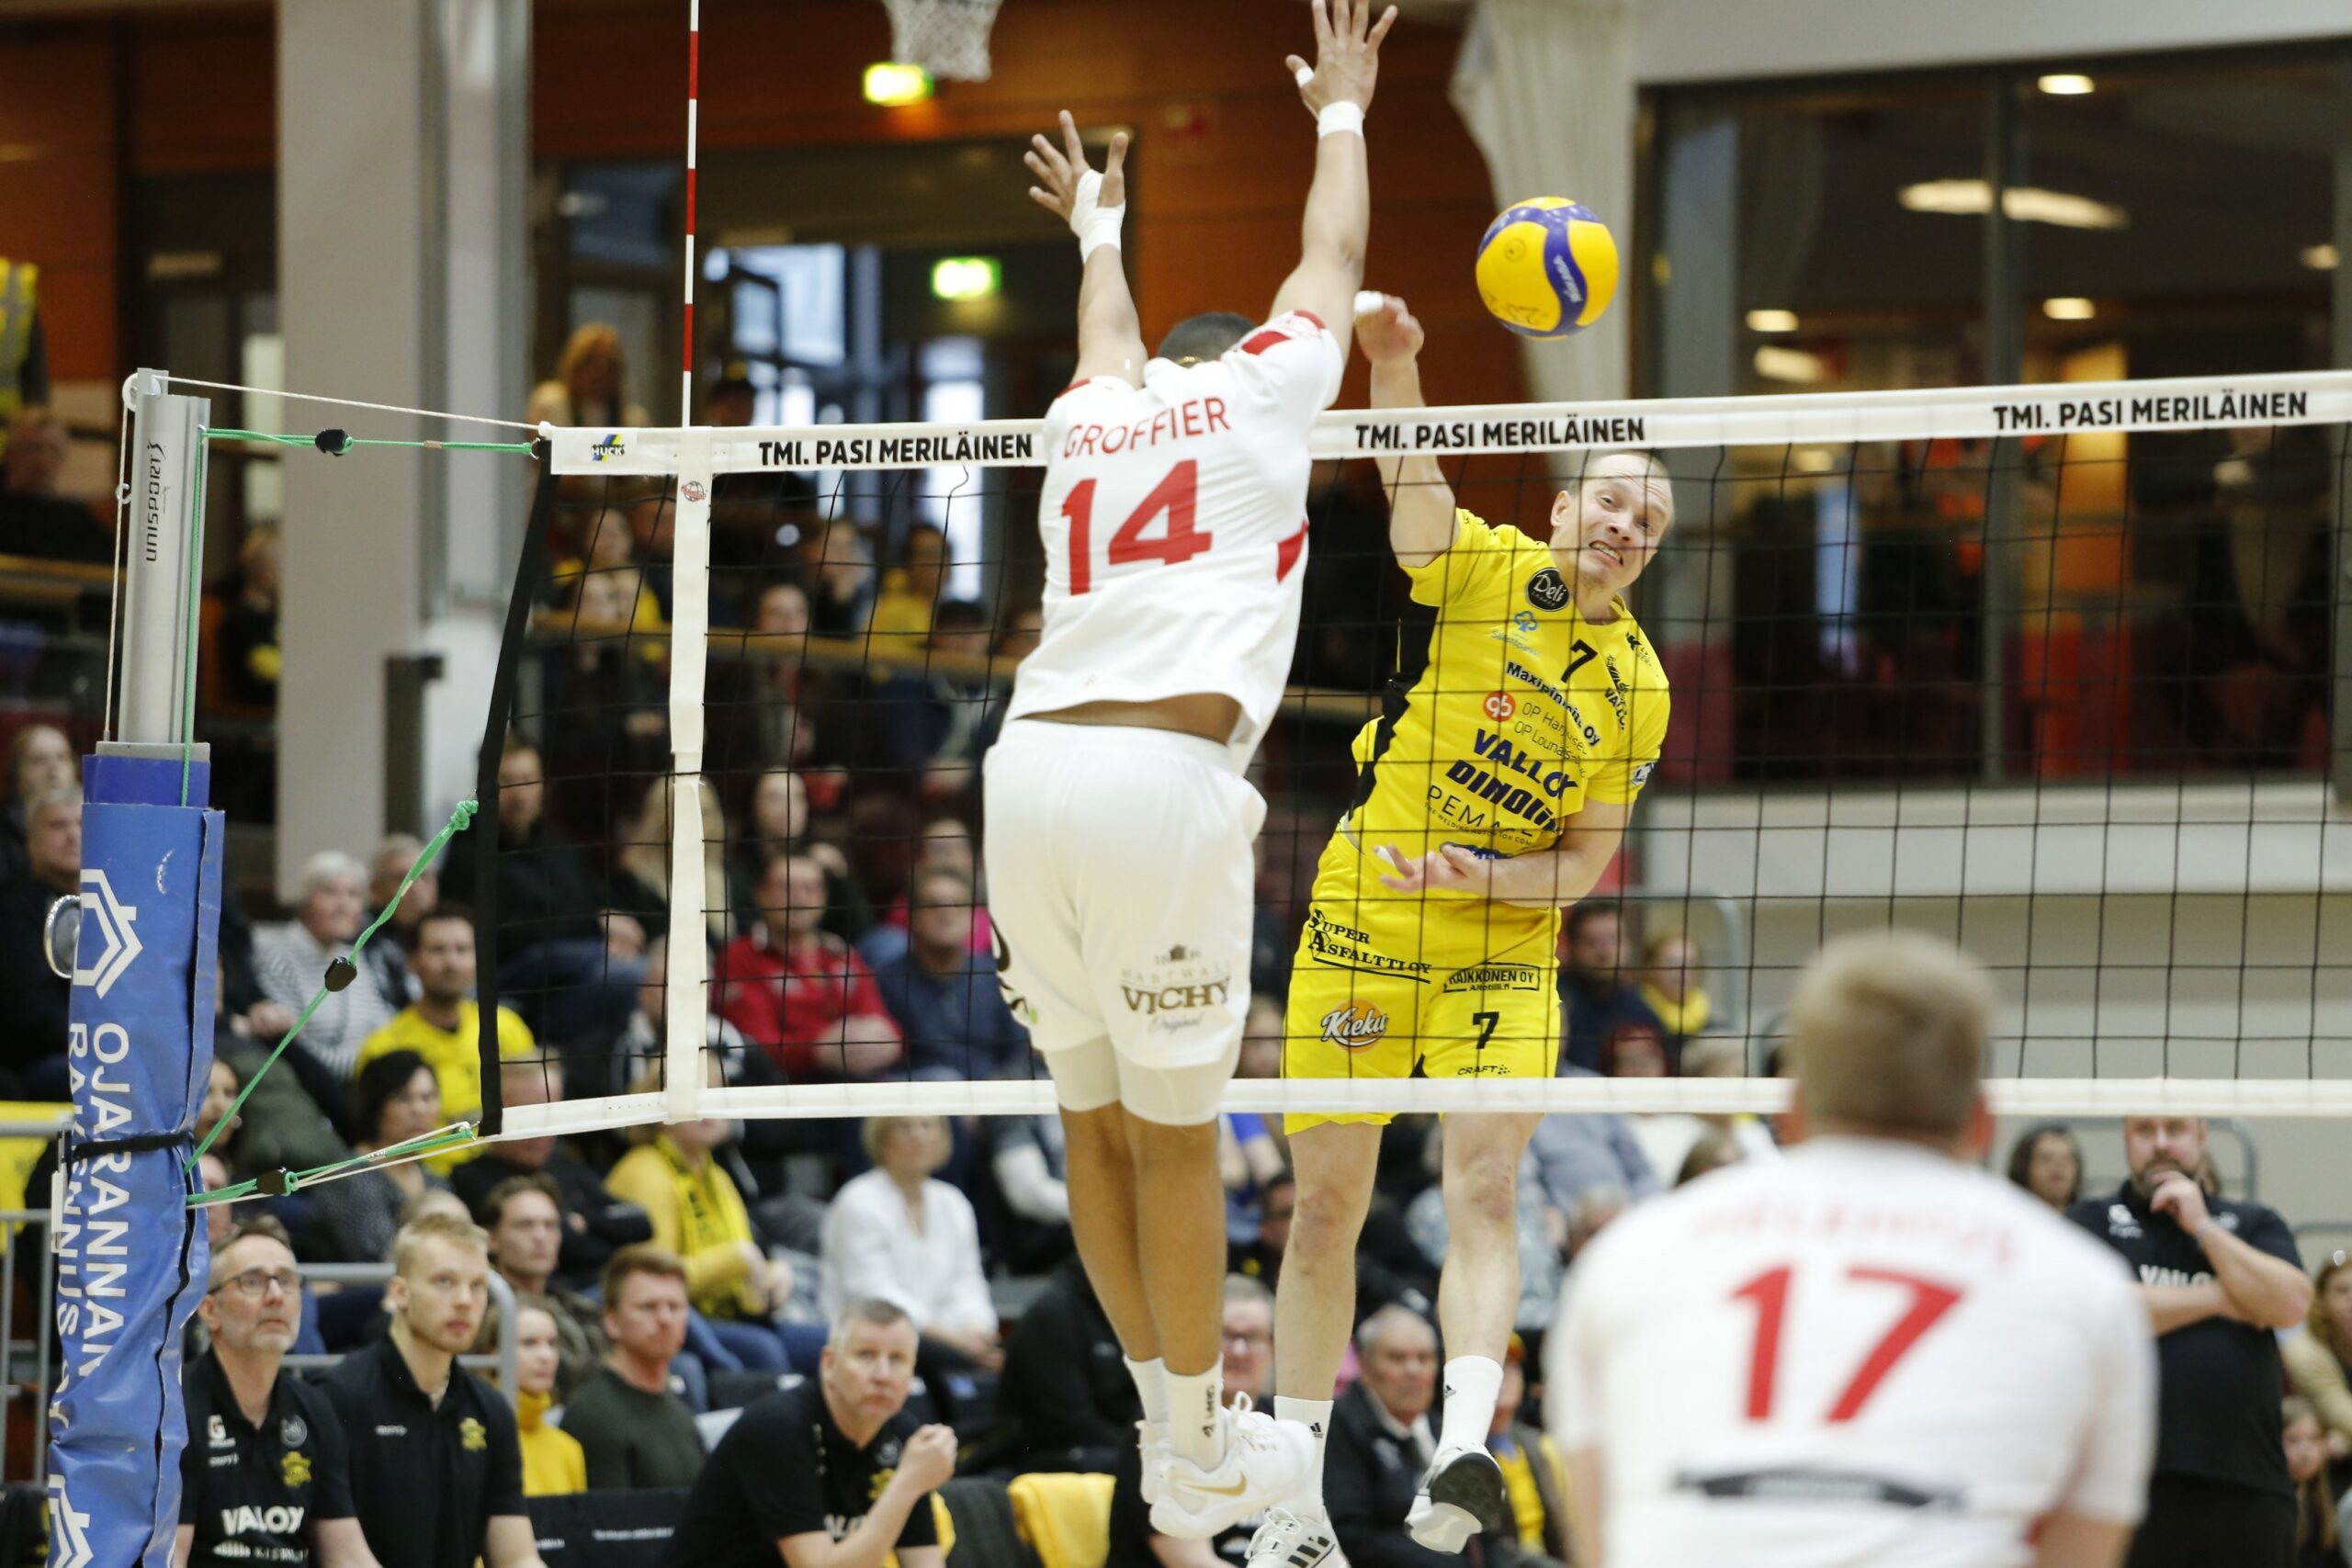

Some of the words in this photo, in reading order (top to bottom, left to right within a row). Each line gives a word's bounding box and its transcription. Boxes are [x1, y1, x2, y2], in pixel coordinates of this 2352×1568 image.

[1064, 397, 1231, 458] GROFFIER
[1994, 404, 2050, 430] TMI.
[2059, 400, 2121, 427] PASI
[2132, 389, 2307, 423] MERILÄINEN
[759, 441, 808, 466] TMI.
[816, 439, 872, 465] PASI
[879, 431, 1032, 463] MERILÄINEN
[1356, 424, 1407, 449] TMI.
[1416, 423, 1474, 448] PASI
[1482, 413, 1645, 446] MERILÄINEN
[591, 444, 625, 457] HUCK
[1061, 458, 1212, 596] 14
[1533, 573, 1566, 603] Deli
[1561, 638, 1599, 683] 7
[1521, 702, 1541, 717] OP
[1514, 720, 1532, 736] OP
[1584, 726, 1600, 747] Oy
[1120, 976, 1231, 1014] VICHY
[1520, 971, 1534, 983] OY
[1321, 1007, 1389, 1043] Kieku
[1473, 1011, 1499, 1050] 7
[1457, 1065, 1498, 1076] CRAFT
[1727, 1262, 1968, 1424] 17
